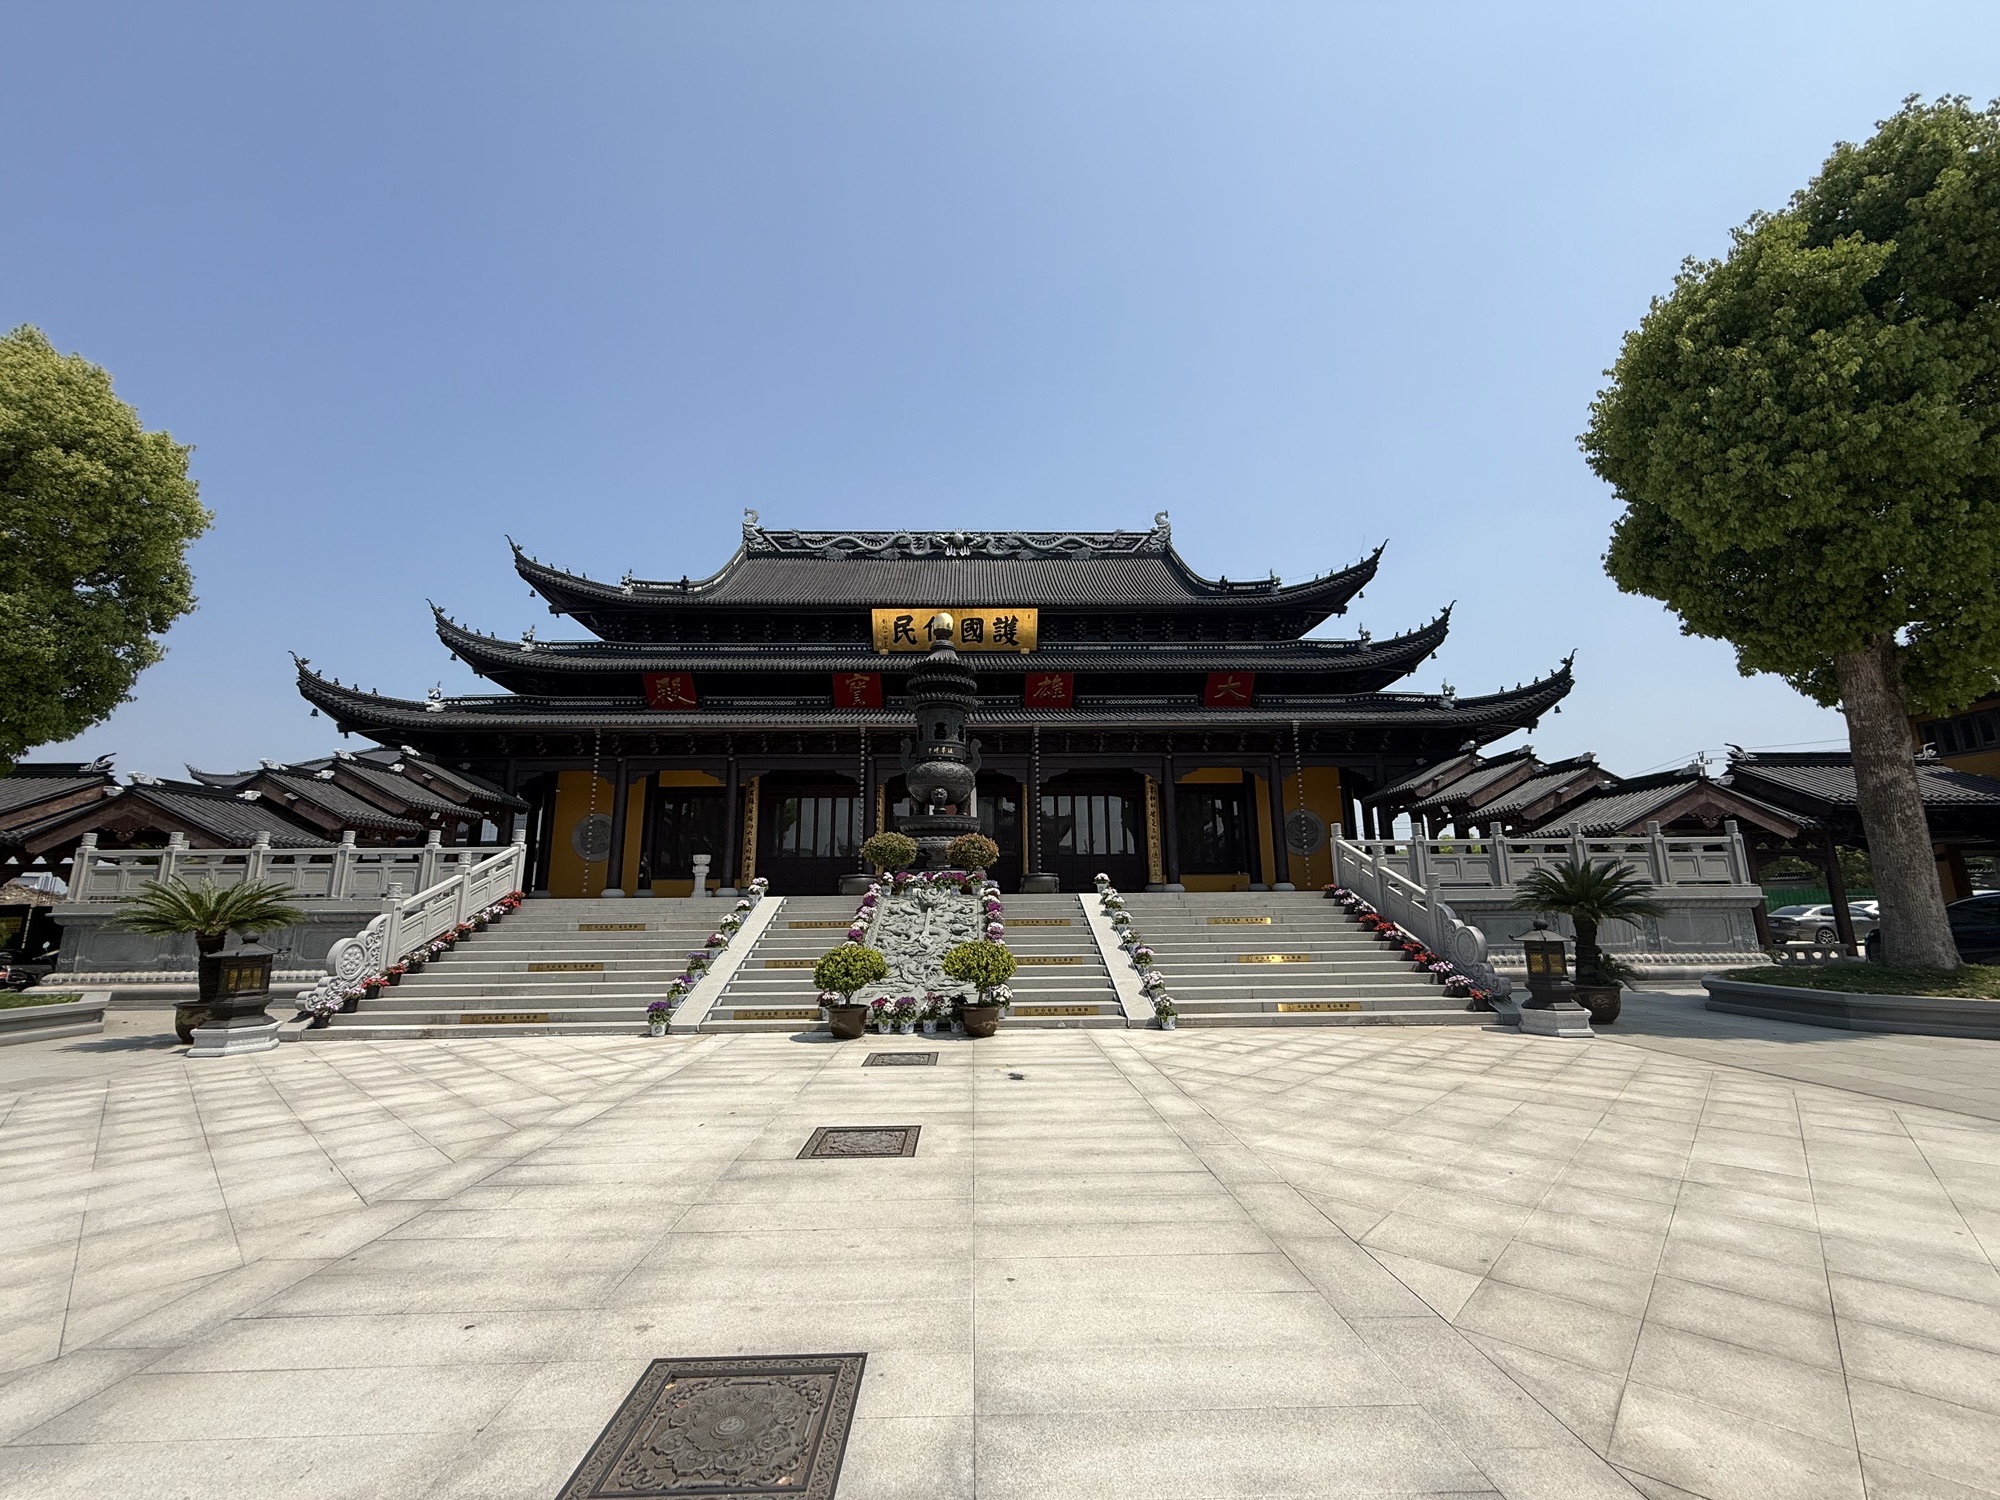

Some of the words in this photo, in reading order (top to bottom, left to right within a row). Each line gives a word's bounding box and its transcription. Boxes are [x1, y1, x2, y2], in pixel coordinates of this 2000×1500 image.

[651, 676, 696, 706] 殿
[845, 673, 871, 706] 寶
[1033, 674, 1066, 701] 雄
[1214, 675, 1247, 699] 大
